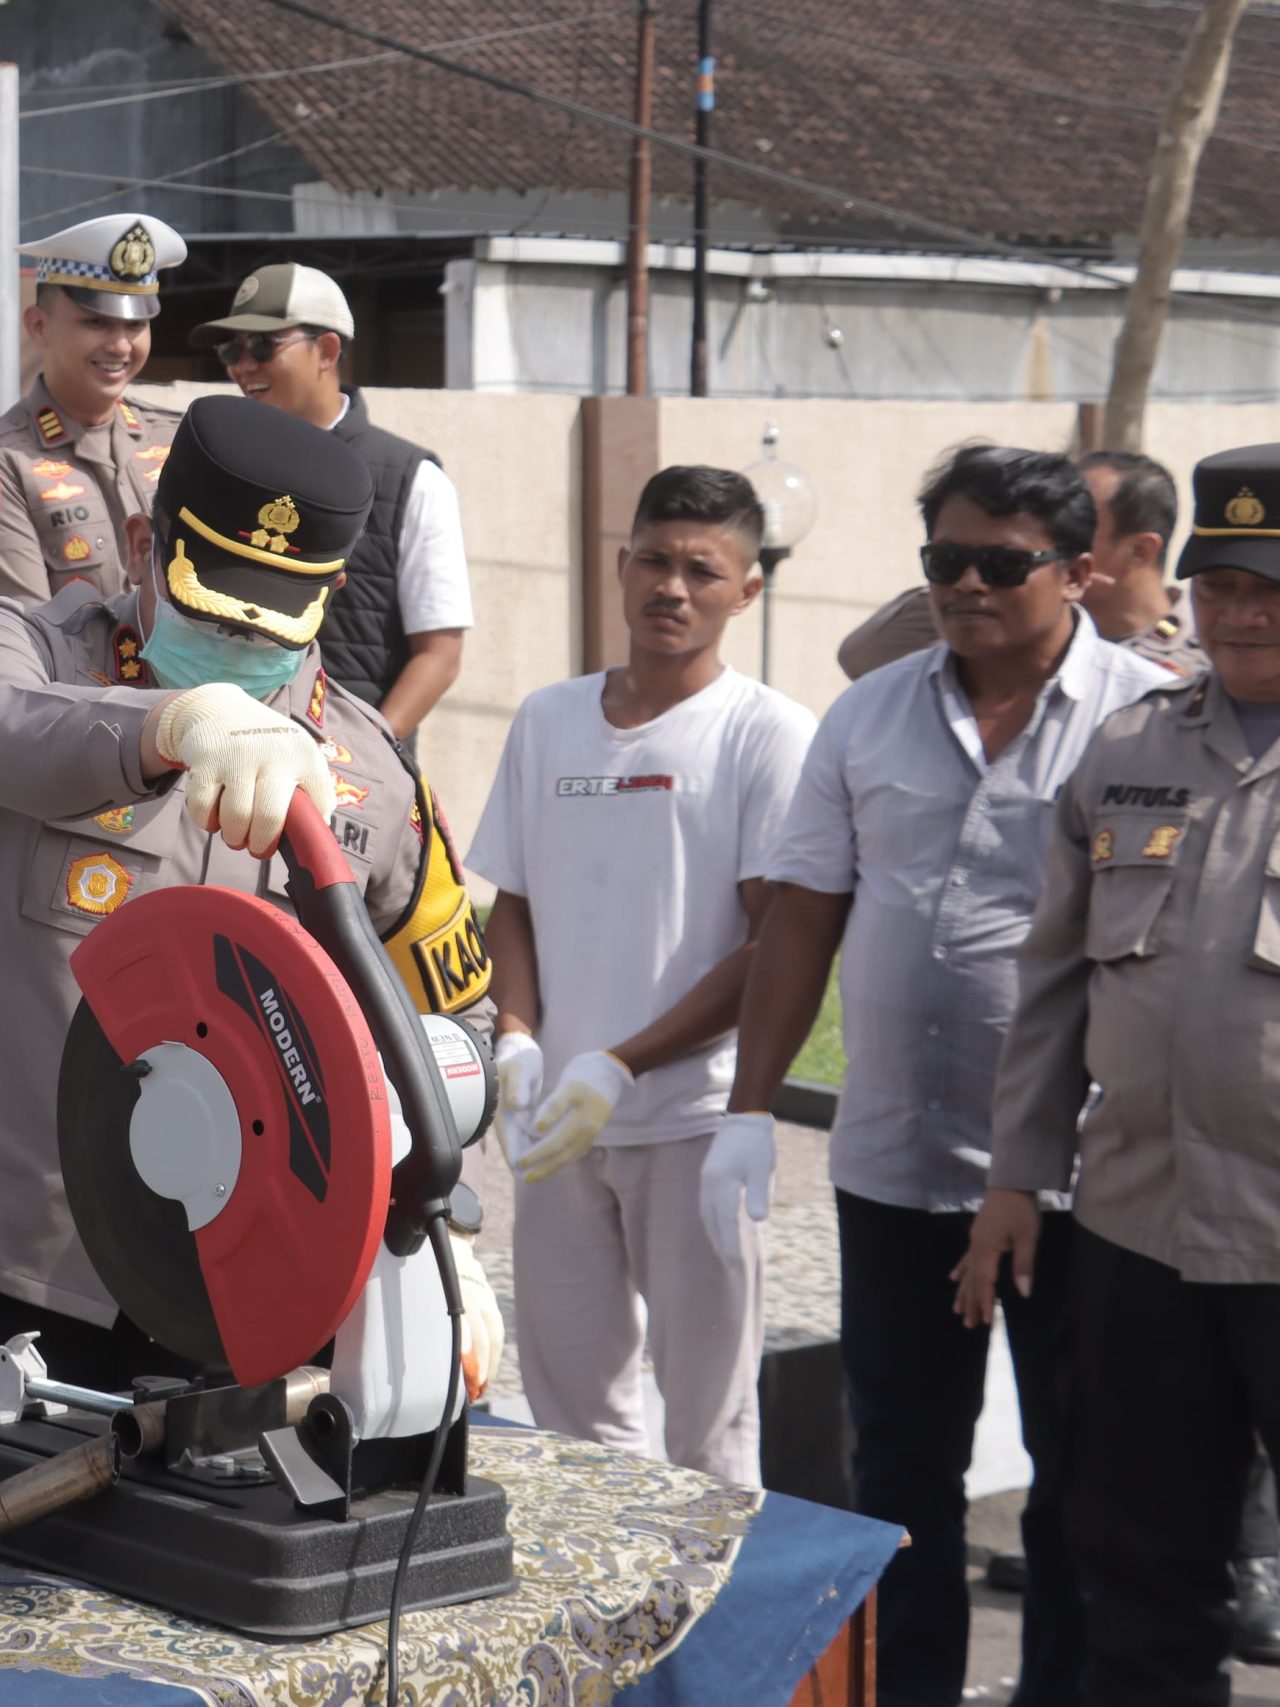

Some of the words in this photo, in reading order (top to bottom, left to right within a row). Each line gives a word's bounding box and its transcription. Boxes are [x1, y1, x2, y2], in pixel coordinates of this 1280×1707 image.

[50, 506, 90, 528] RIO
[330, 814, 370, 855] LRI
[260, 988, 315, 1105] MODERN
